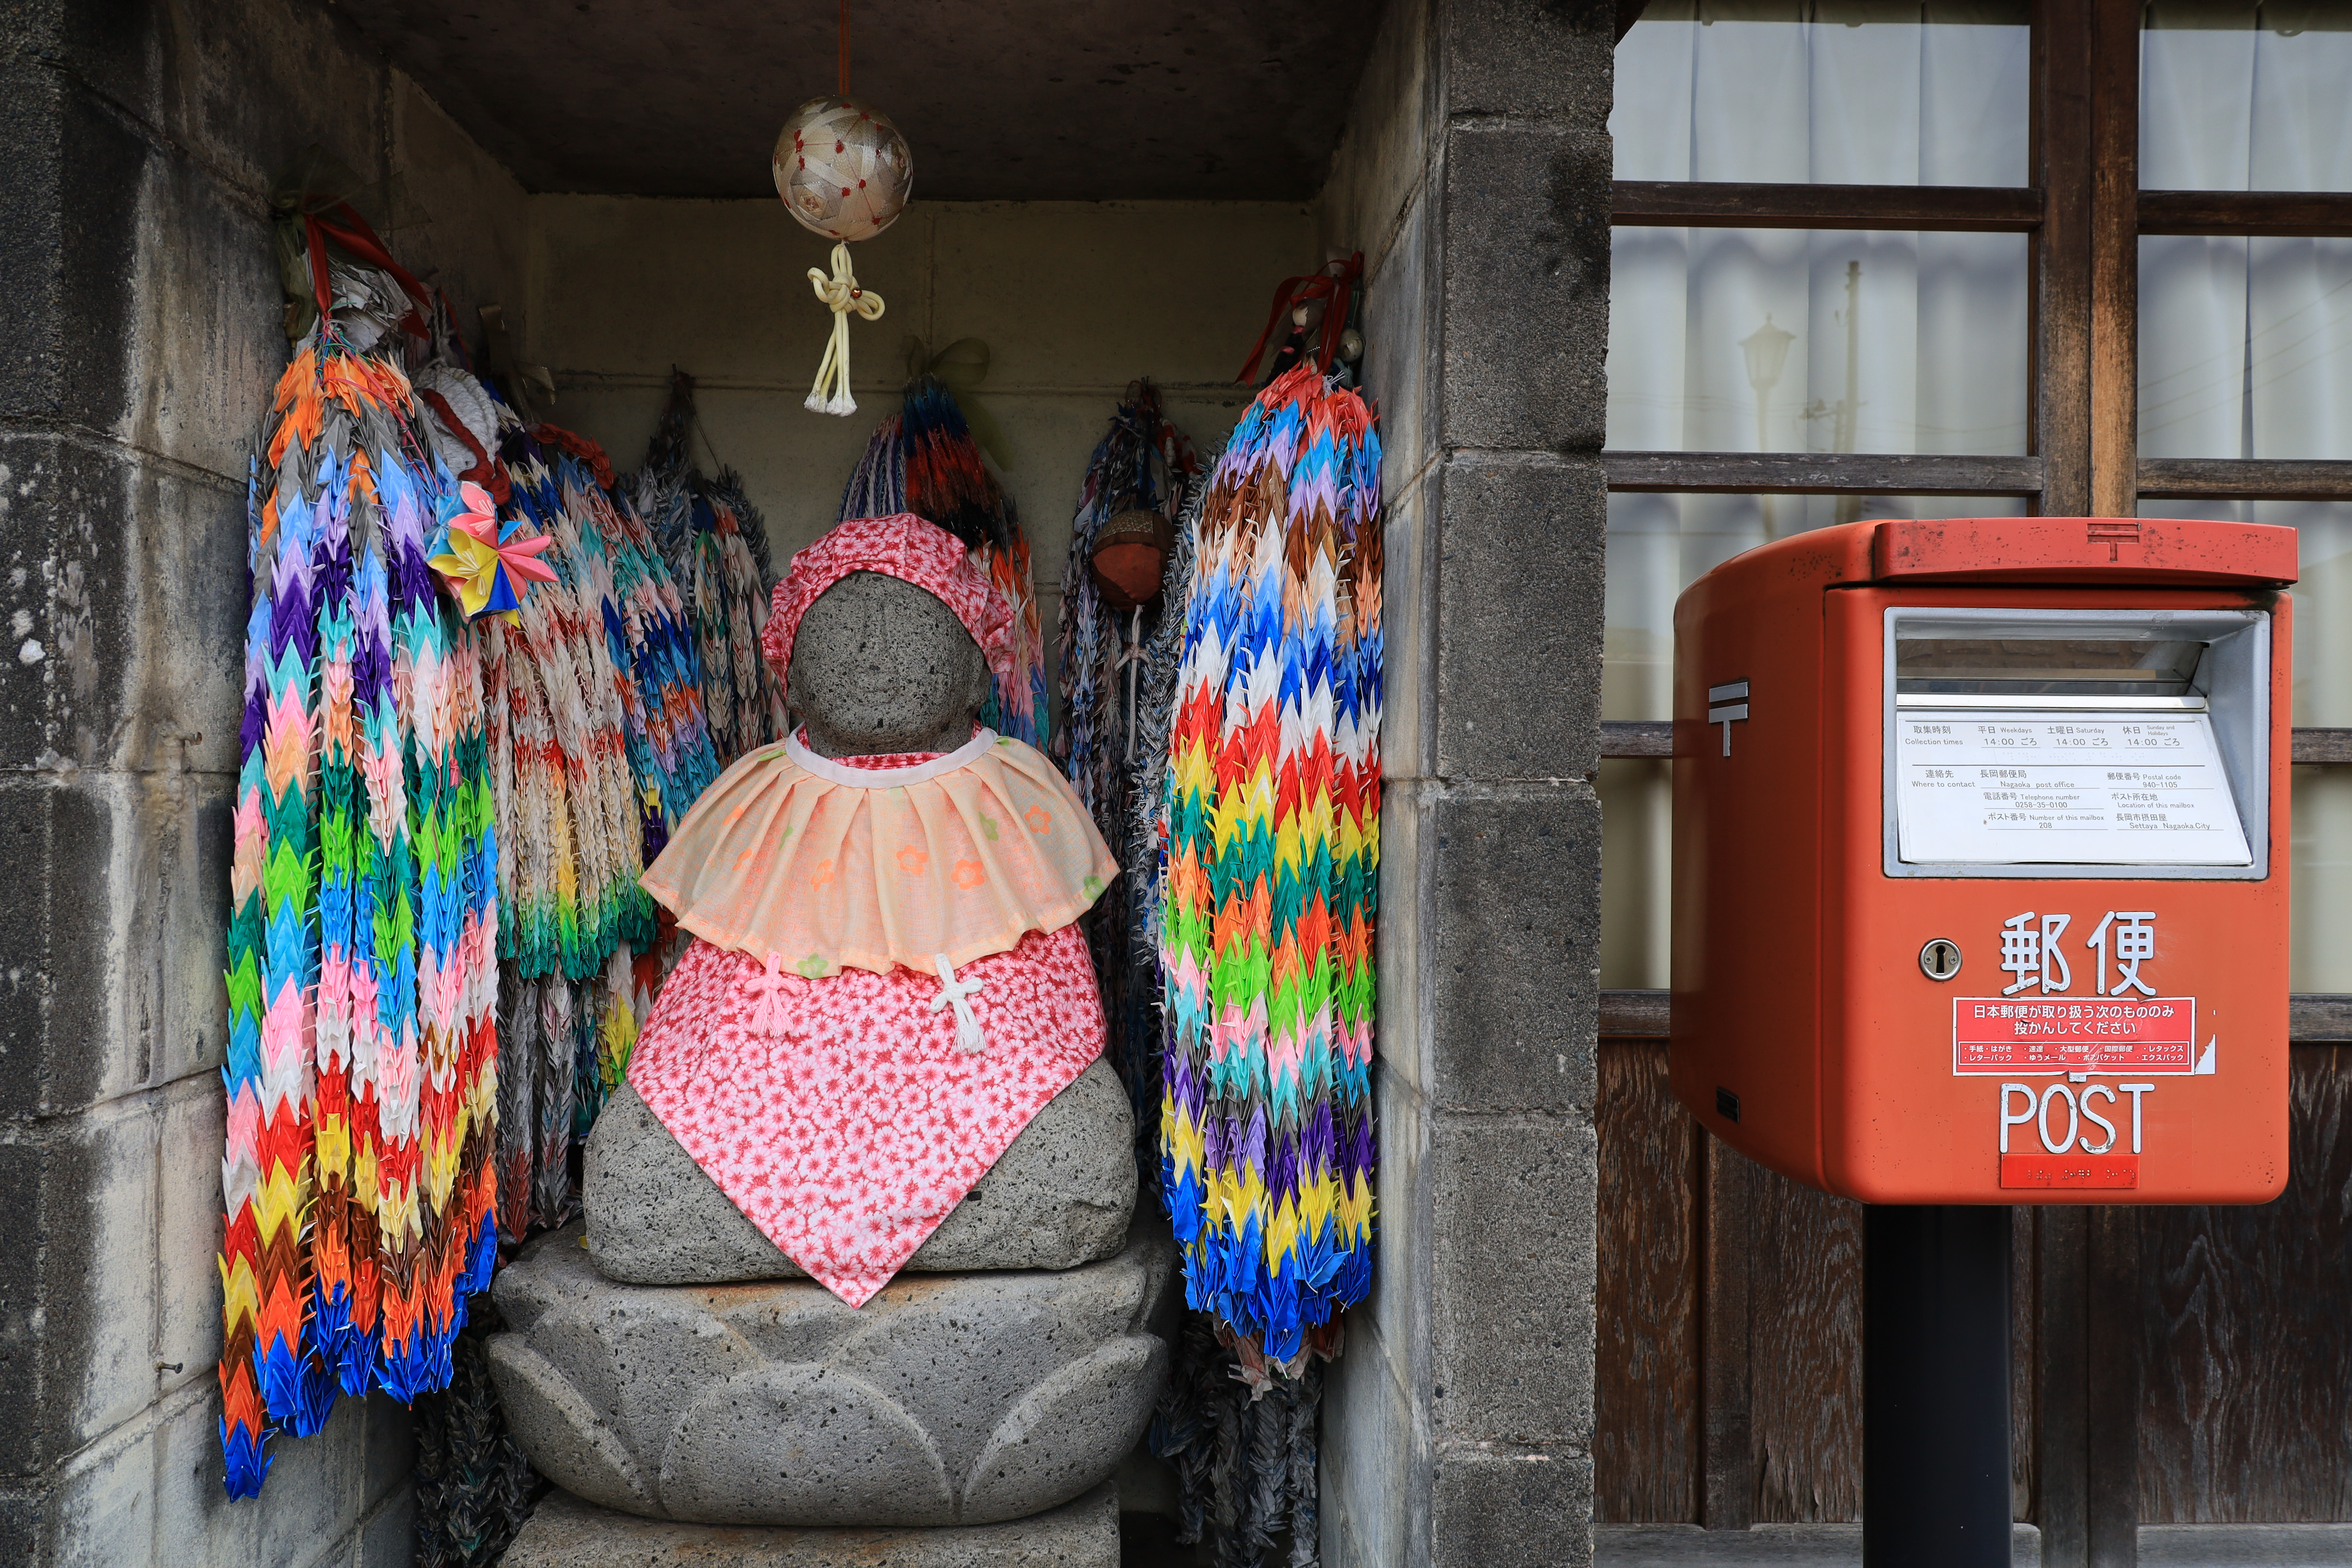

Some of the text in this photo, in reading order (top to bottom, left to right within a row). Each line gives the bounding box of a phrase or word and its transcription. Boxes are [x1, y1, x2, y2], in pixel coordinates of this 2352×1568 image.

[1913, 725, 1951, 734] 取集時刻
[2047, 726, 2074, 734] 土曜日
[2122, 726, 2141, 735] 休日
[2021, 737, 2037, 746] ごろ
[2092, 737, 2109, 746] ごろ
[2164, 738, 2180, 746] ごろ
[1925, 769, 1954, 778] 連絡先
[1980, 769, 2027, 778] 長岡郵便局
[1983, 792, 2017, 800] 電話番号
[2111, 792, 2158, 801] ポスト所在地
[1988, 812, 2027, 821] ポスト番号
[2000, 911, 2157, 996] 郵便
[1975, 1004, 2174, 1020] 日本郵便が取り扱う次のもののみ
[2014, 1021, 2136, 1035] 投かんしてください
[2000, 1083, 2155, 1154] POST
